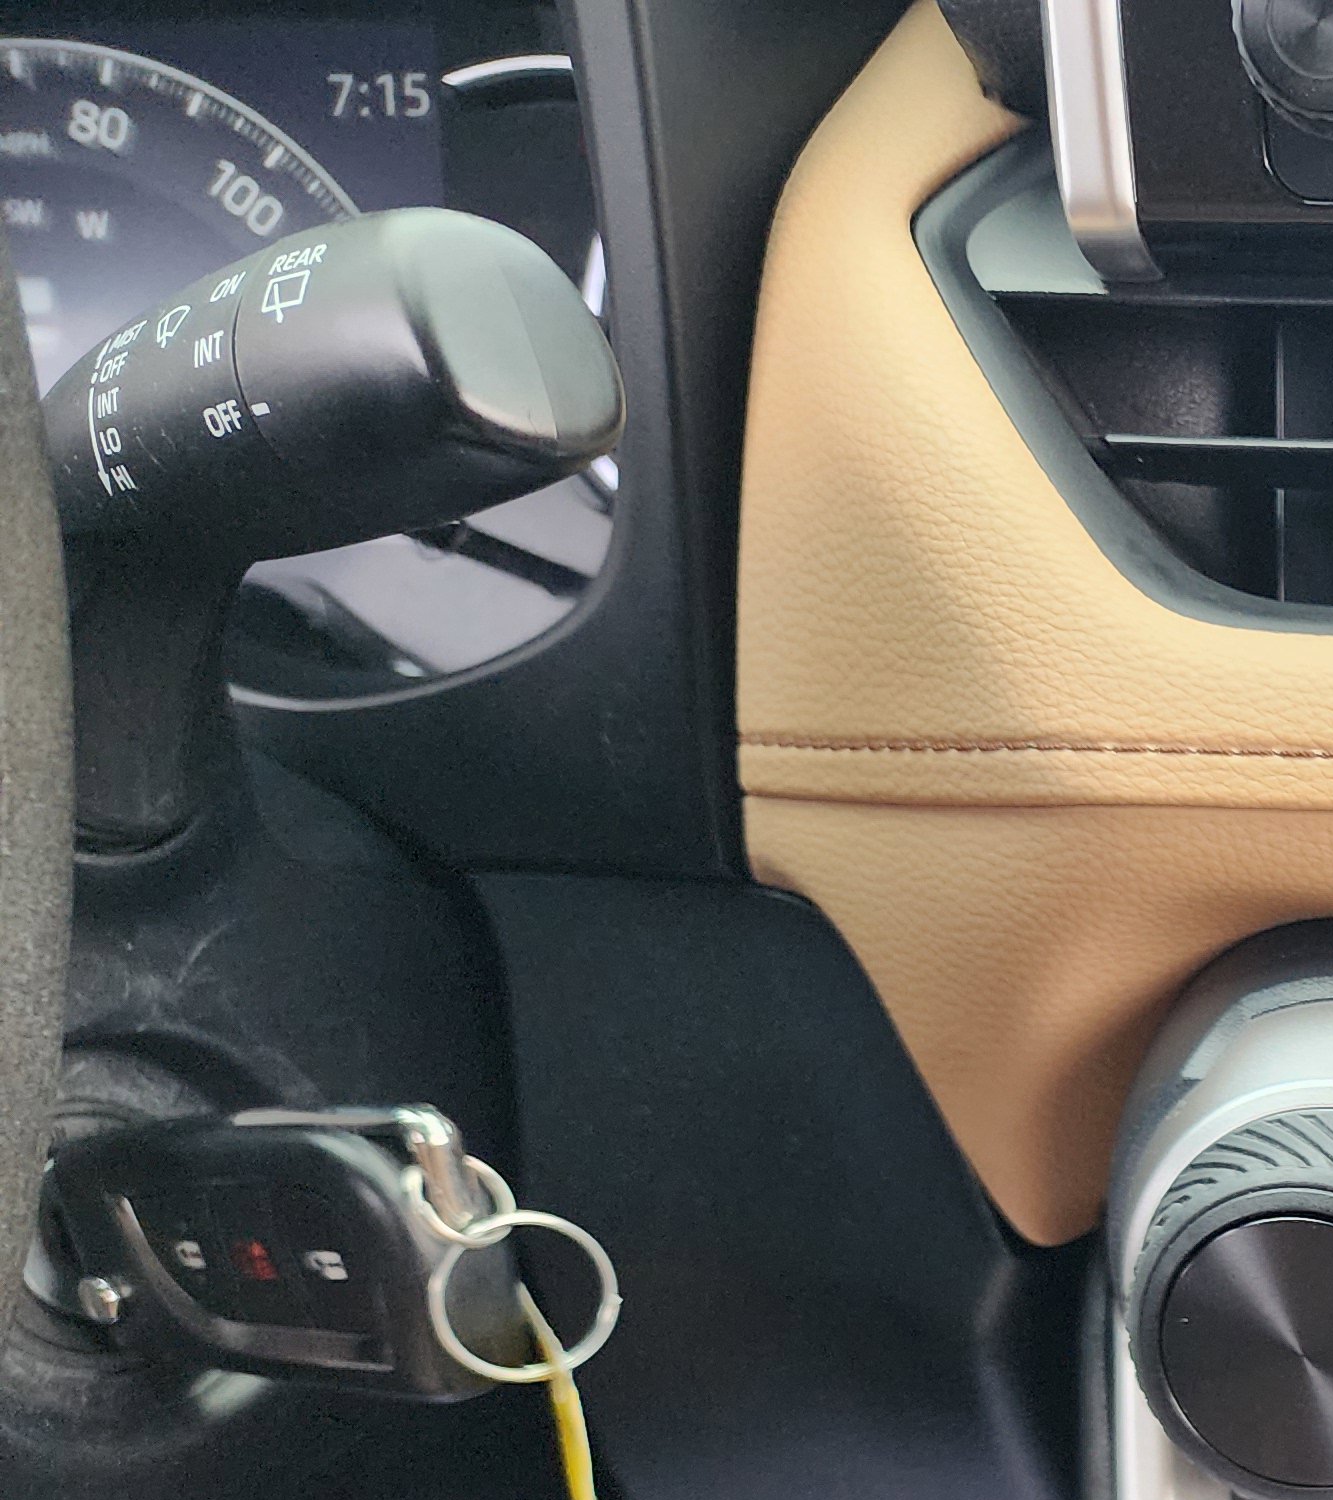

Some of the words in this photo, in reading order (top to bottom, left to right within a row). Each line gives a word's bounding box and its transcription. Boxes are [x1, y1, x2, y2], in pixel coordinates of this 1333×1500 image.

[327, 72, 431, 118] 7:15
[67, 99, 129, 150] 80
[206, 158, 283, 237] 100
[268, 243, 327, 276] REAR
[210, 271, 247, 303] ON
[108, 320, 148, 354] MIST
[194, 329, 224, 369] INT
[99, 351, 129, 384] OFF
[97, 386, 120, 419] INT
[202, 399, 242, 438] OFF
[99, 427, 122, 456] LO
[109, 464, 137, 492] HI
